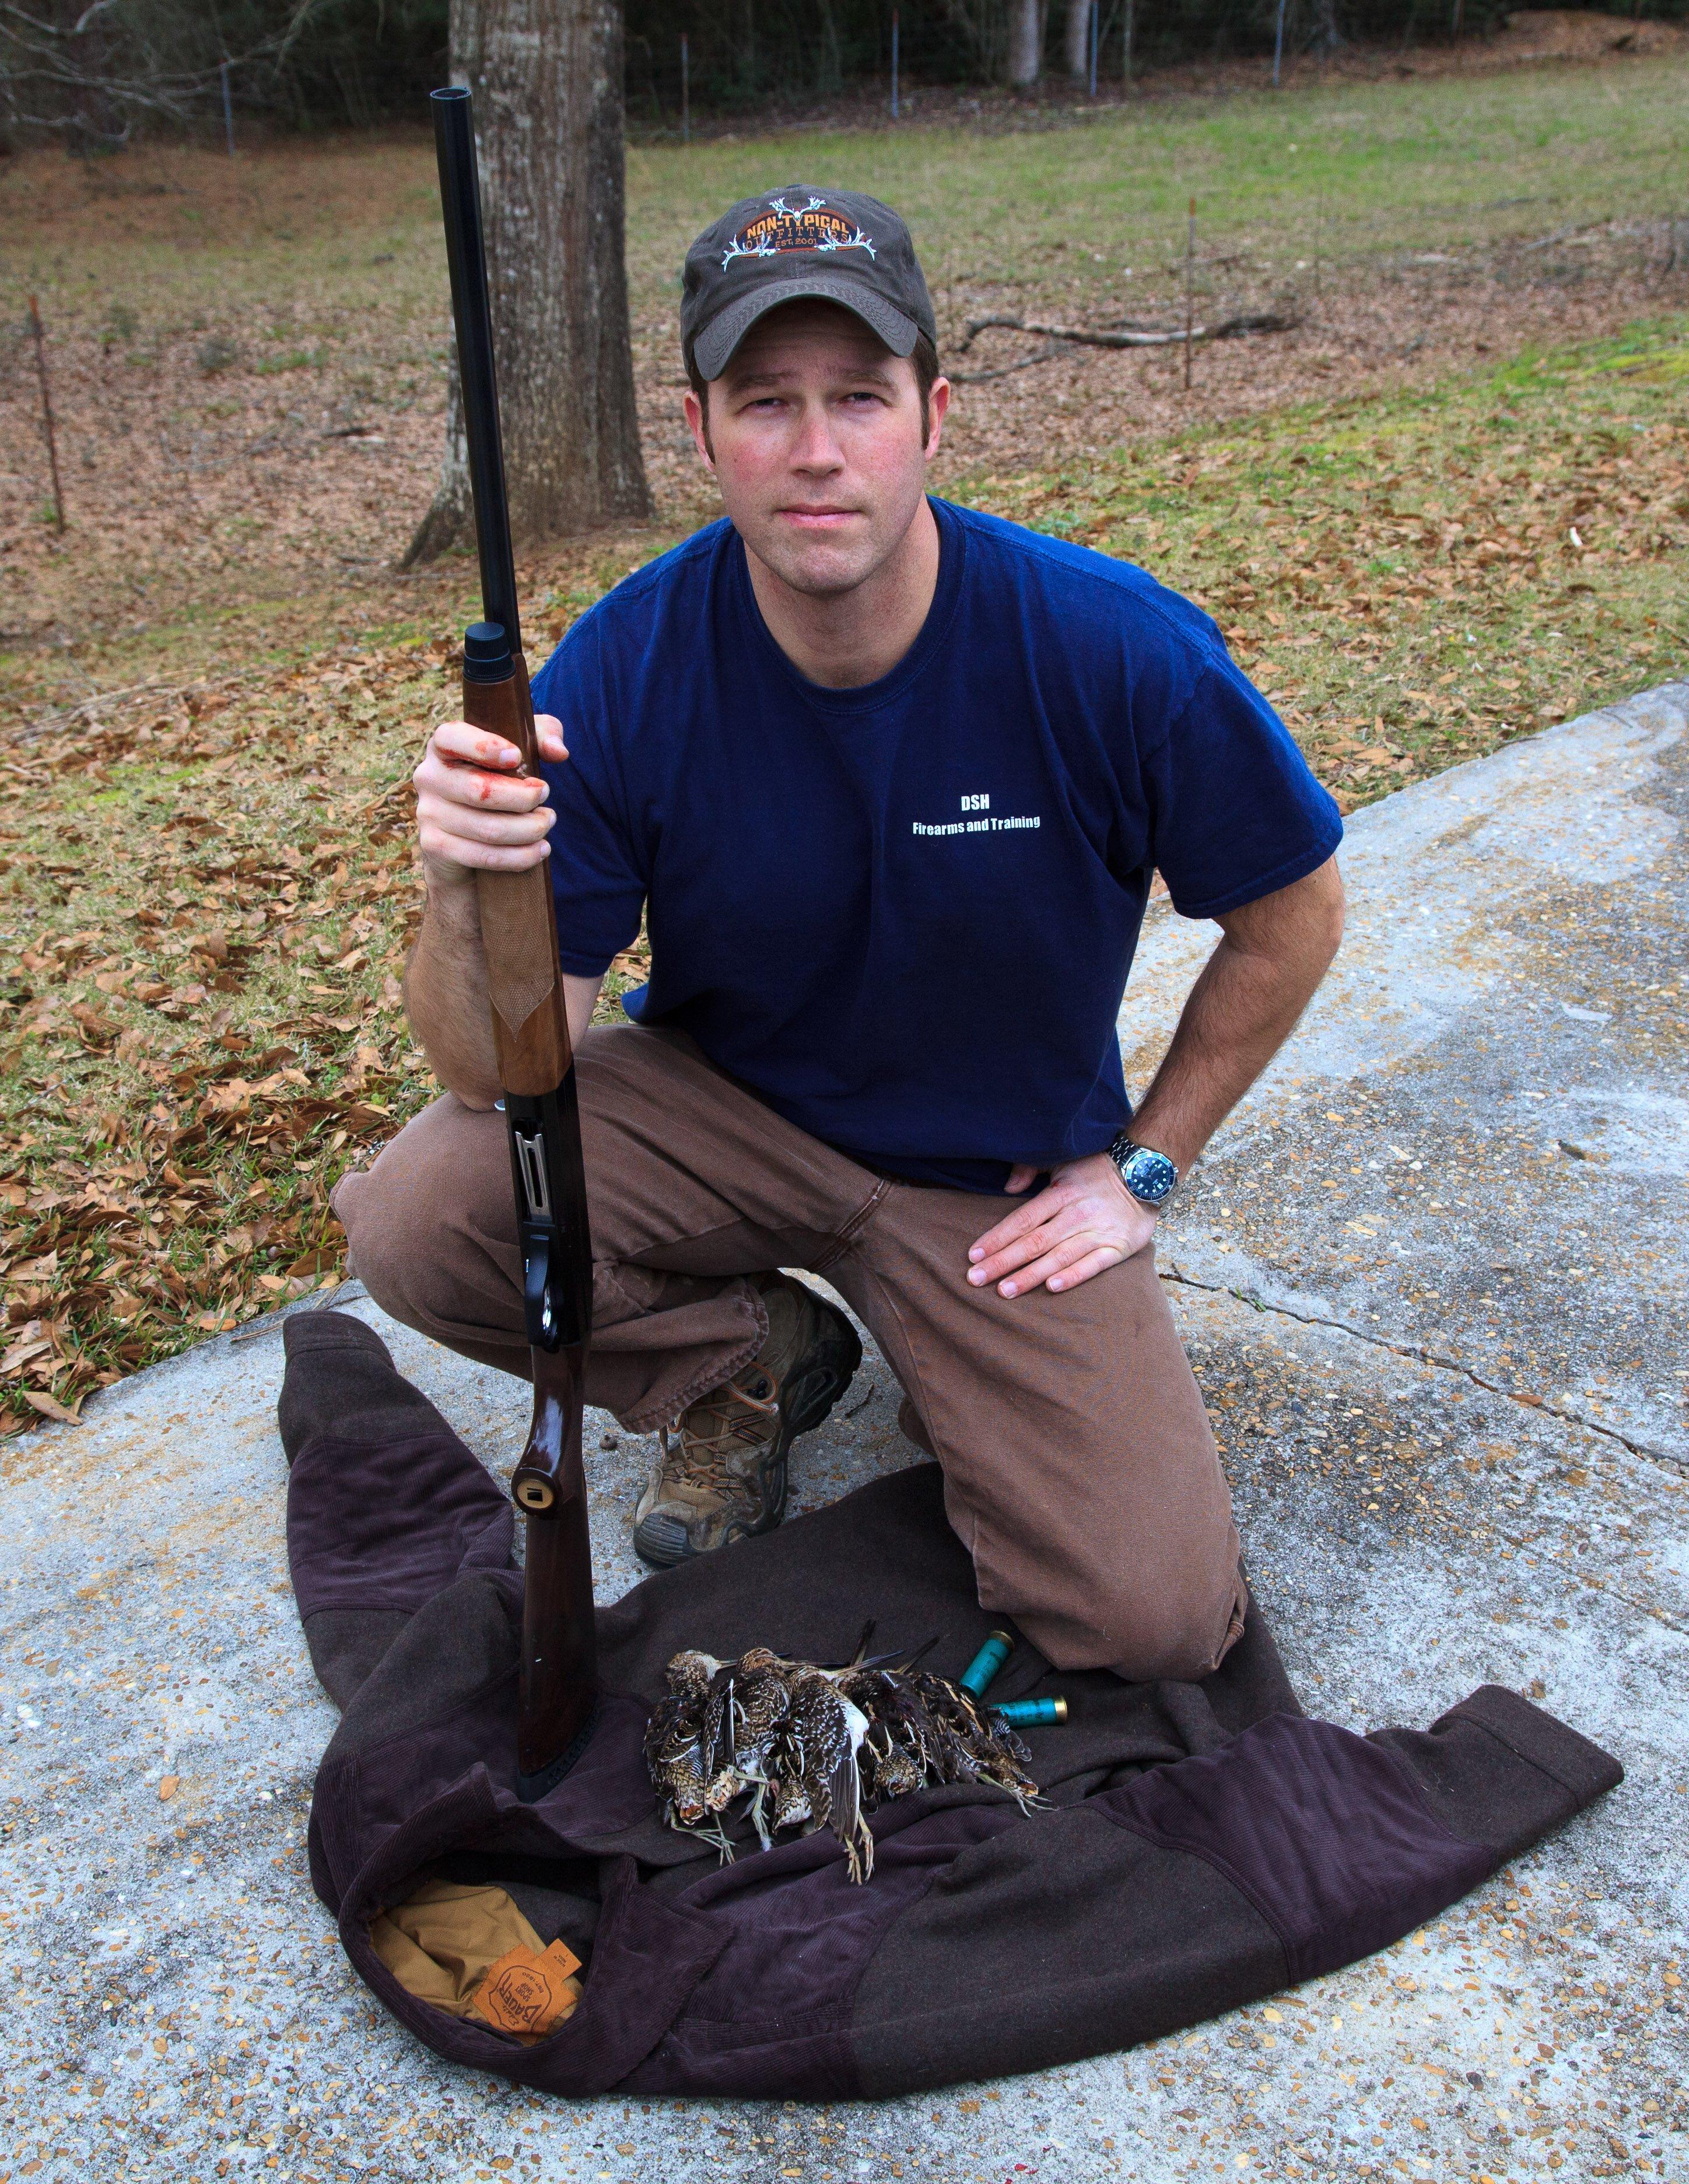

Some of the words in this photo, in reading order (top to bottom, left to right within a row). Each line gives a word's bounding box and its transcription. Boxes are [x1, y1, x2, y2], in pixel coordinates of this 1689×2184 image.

[747, 215, 850, 239] NON-TYPICAL
[746, 227, 849, 250] OUTFITTERS
[961, 794, 990, 811] DSH
[913, 822, 965, 835] Firearms
[966, 818, 989, 832] and
[991, 816, 1040, 831] Training
[498, 1973, 542, 2024] BAUER
[521, 1982, 534, 1996] SHOP
